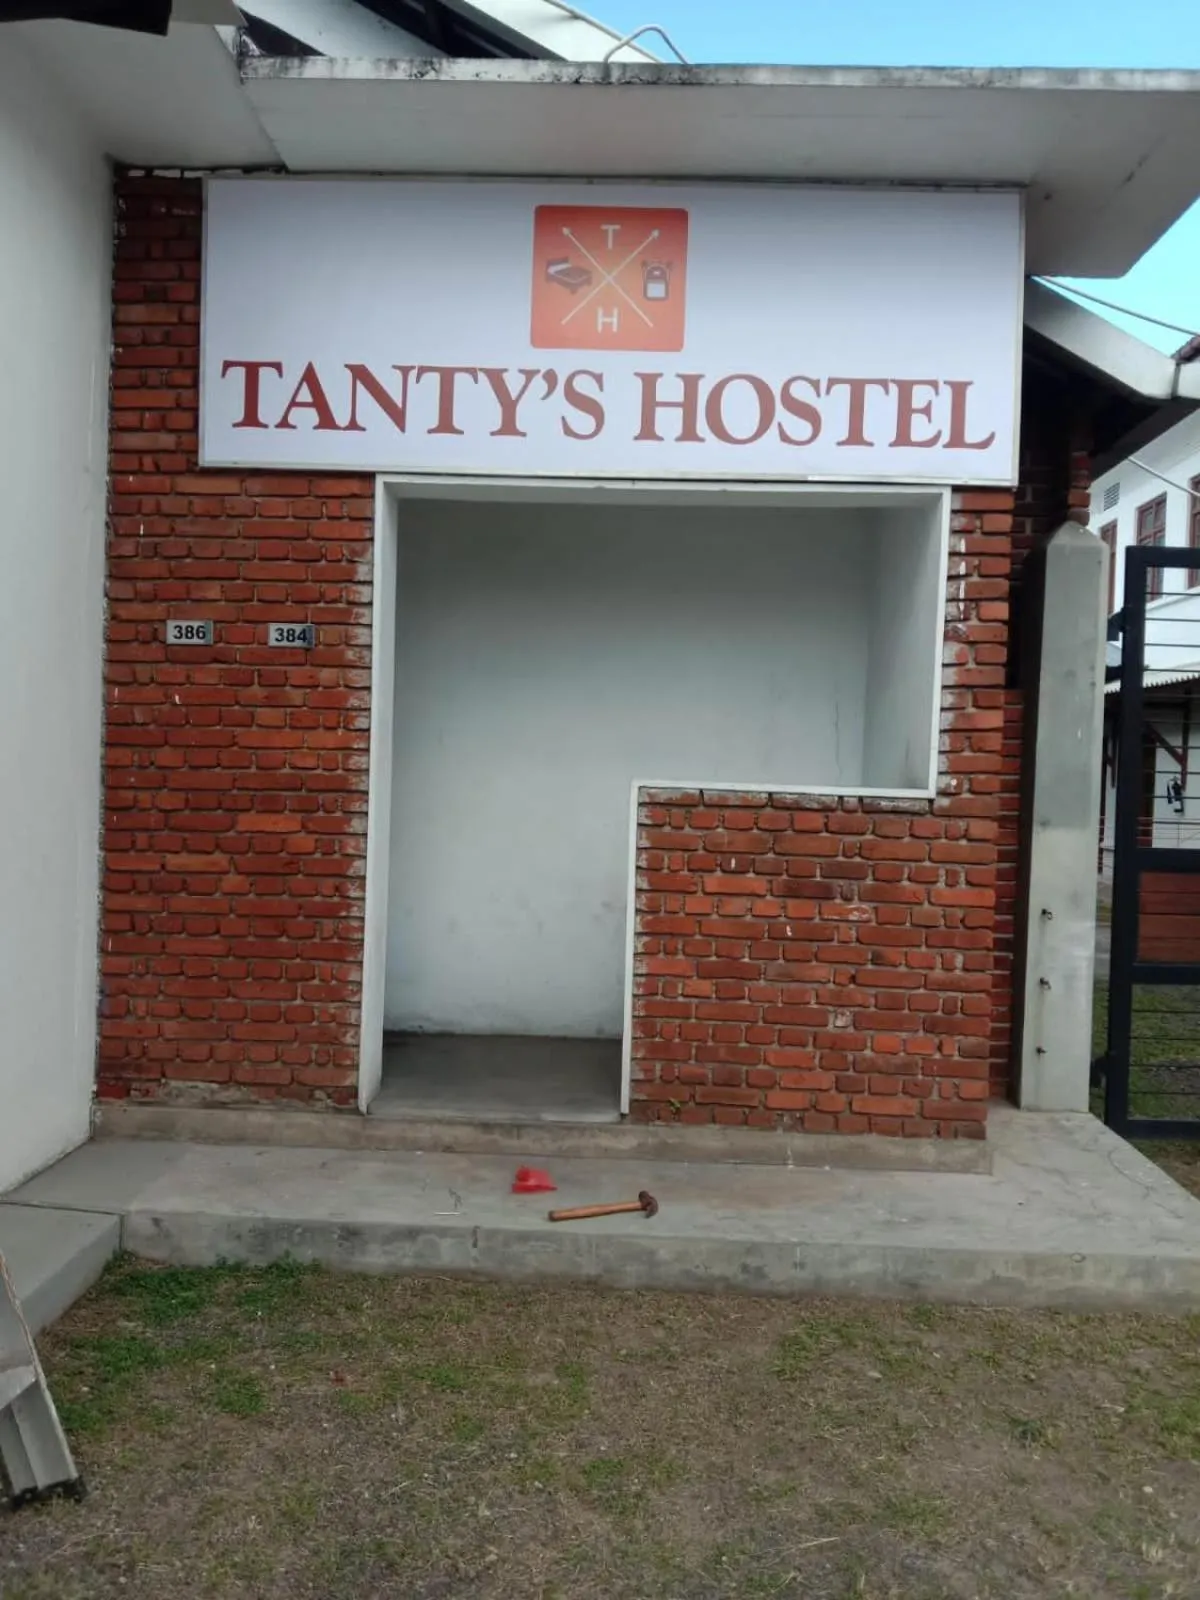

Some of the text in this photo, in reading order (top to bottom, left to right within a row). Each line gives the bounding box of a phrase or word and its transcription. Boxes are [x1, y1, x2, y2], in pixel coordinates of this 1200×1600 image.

[600, 224, 621, 250] T
[597, 306, 618, 334] H
[221, 360, 997, 451] TANTY'S HOSTEL
[173, 624, 207, 640] 386
[274, 627, 308, 643] 384
